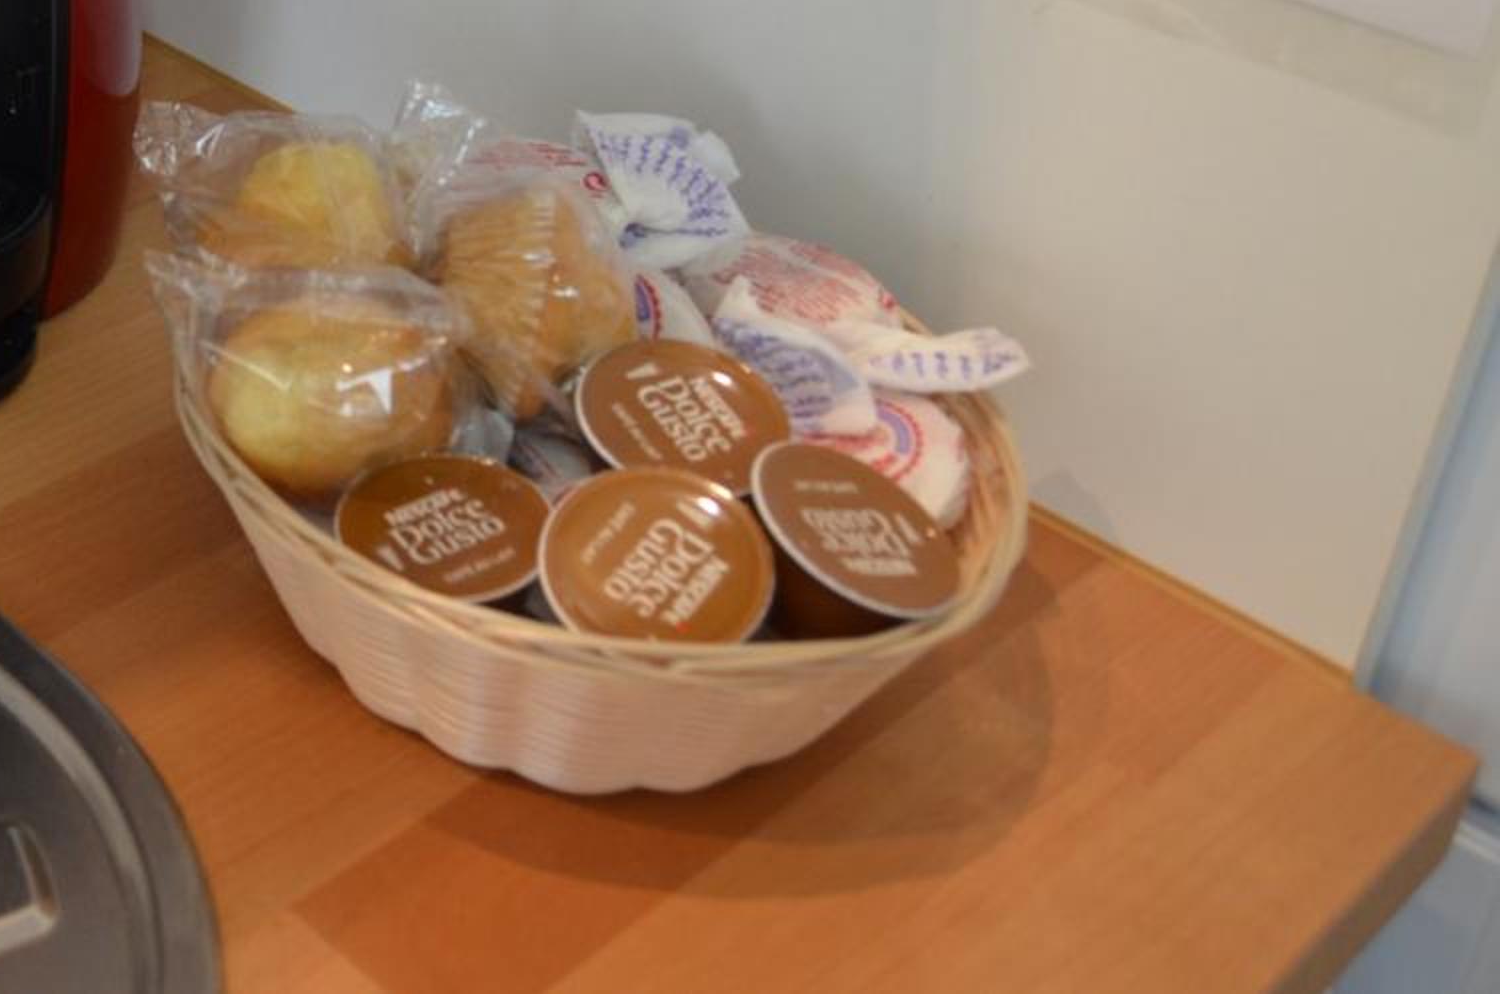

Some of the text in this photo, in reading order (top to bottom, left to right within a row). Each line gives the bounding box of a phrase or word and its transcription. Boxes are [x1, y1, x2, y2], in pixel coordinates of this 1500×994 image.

[637, 384, 707, 461] Gusto
[657, 375, 732, 453] Dolce
[389, 499, 484, 549] Dolce
[409, 516, 504, 564] Gusto
[603, 518, 684, 600] Gusto
[628, 531, 714, 617] Dolce
